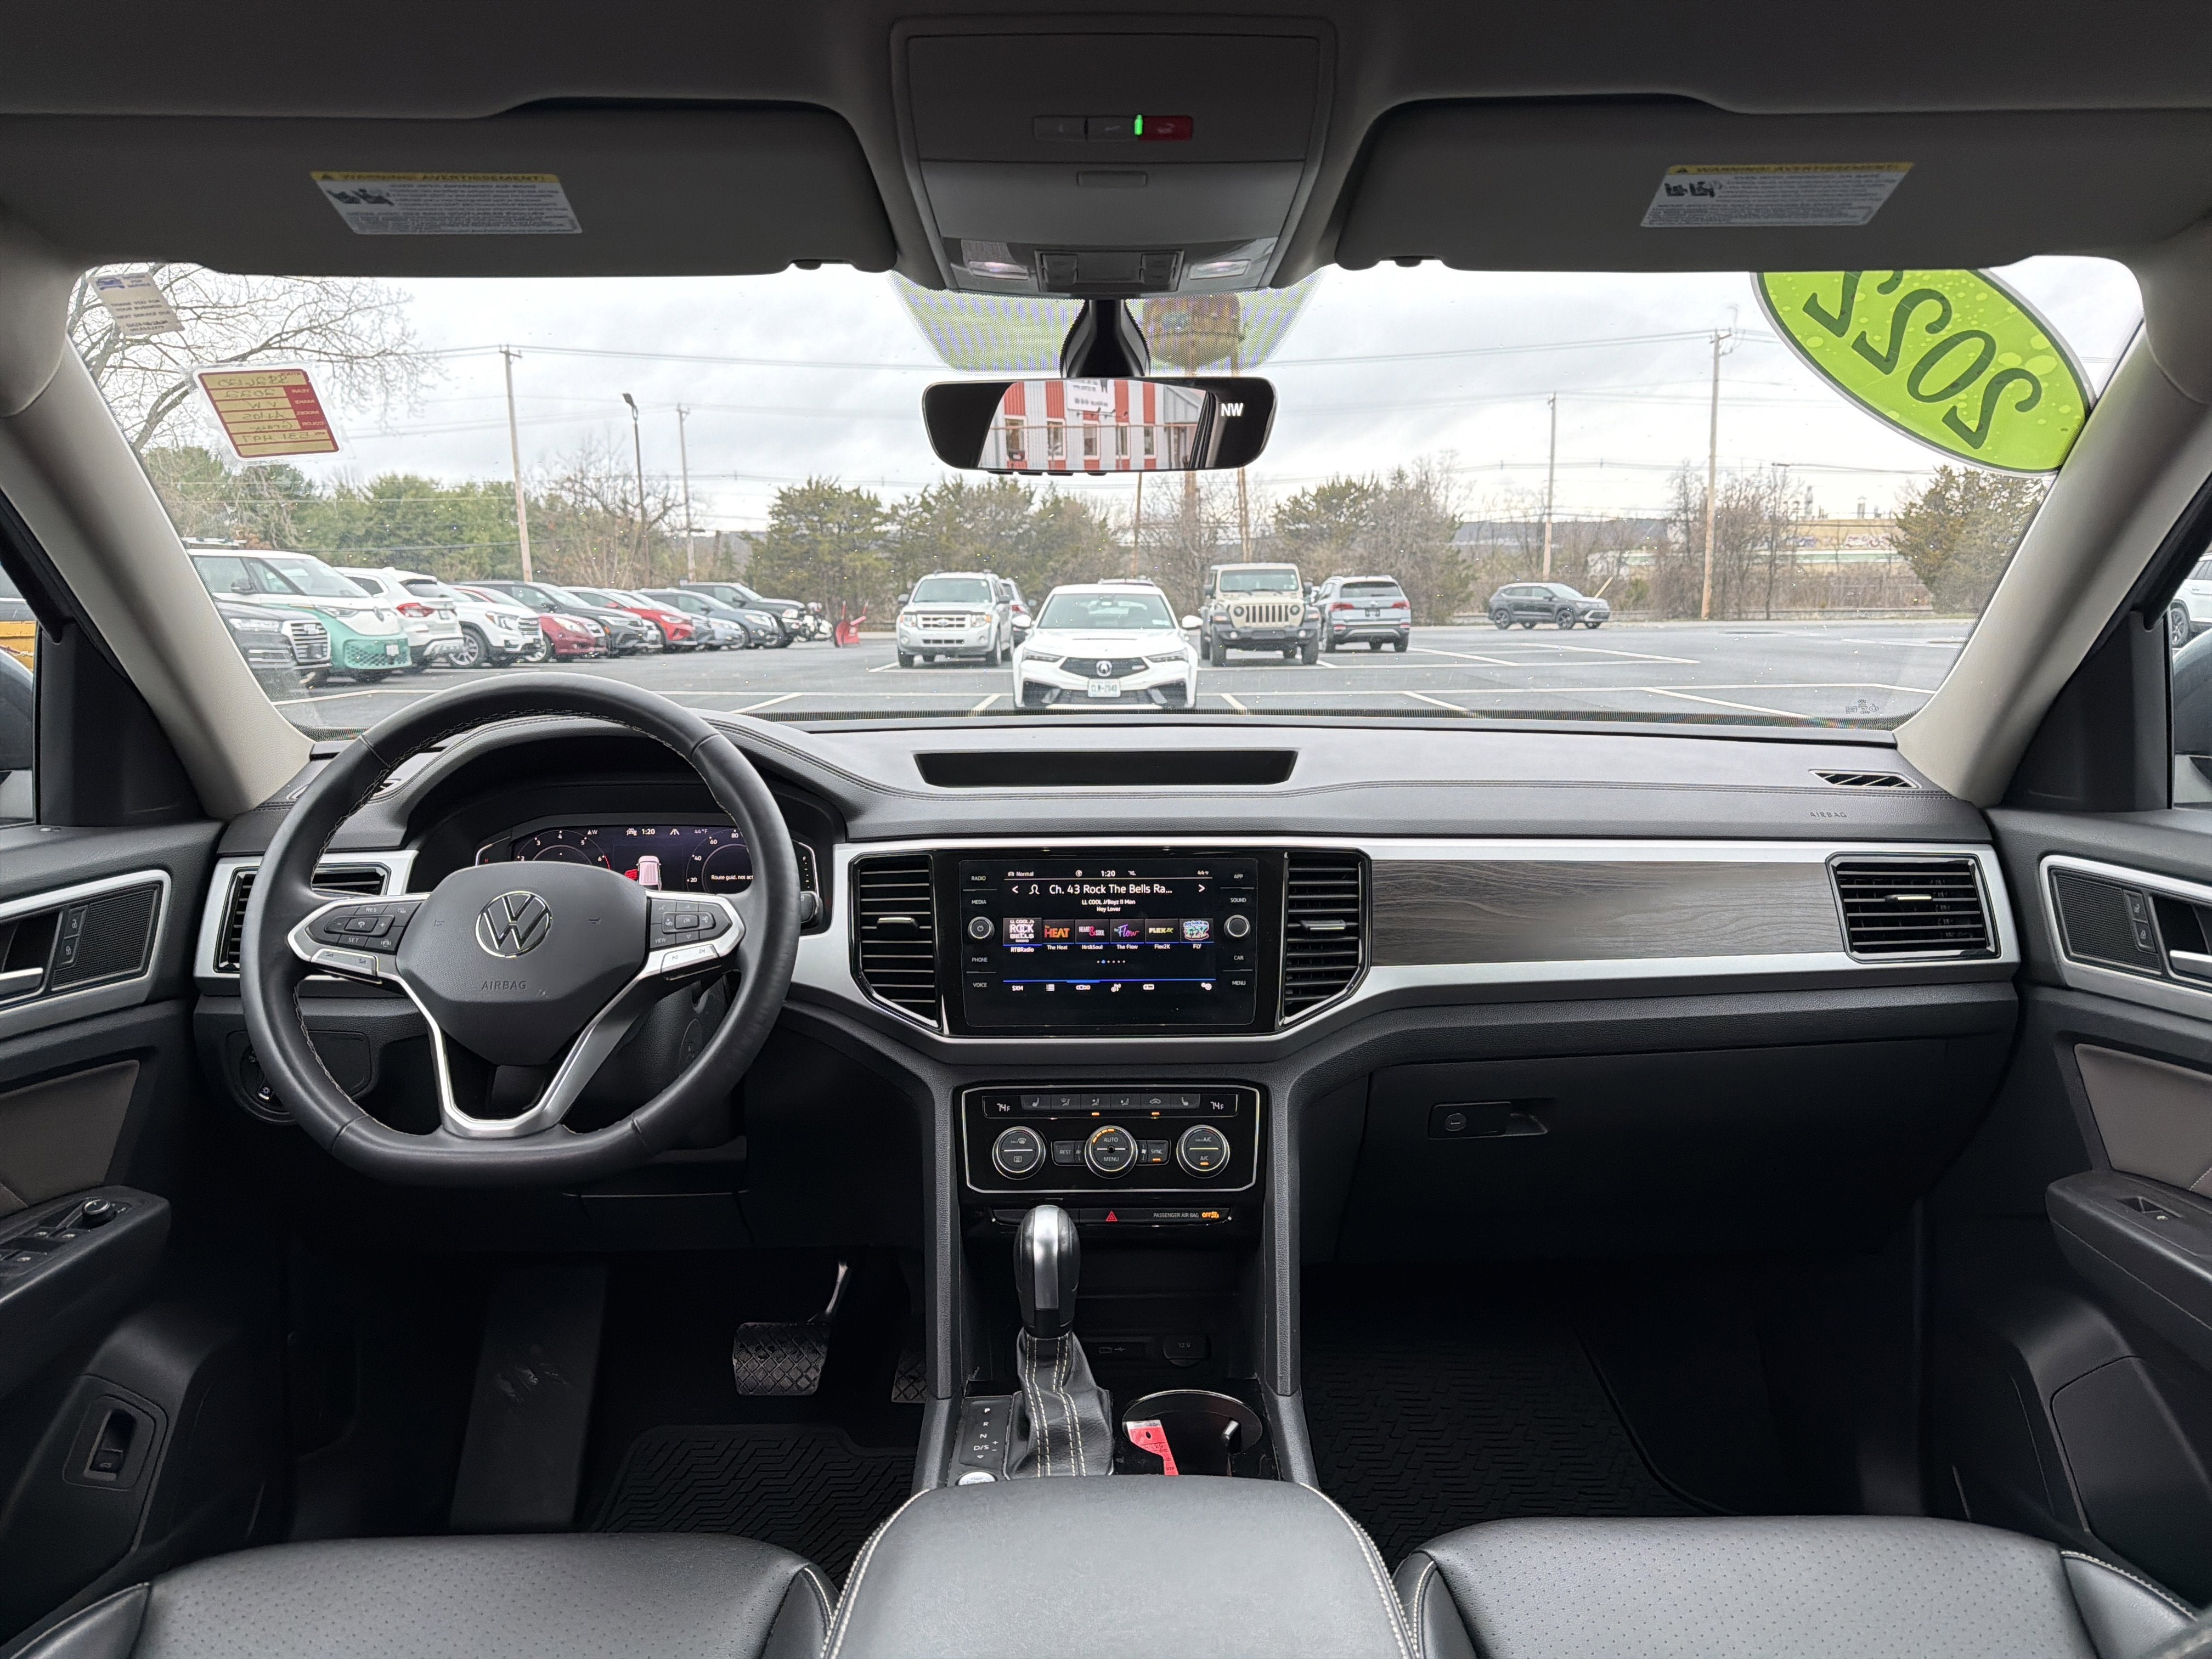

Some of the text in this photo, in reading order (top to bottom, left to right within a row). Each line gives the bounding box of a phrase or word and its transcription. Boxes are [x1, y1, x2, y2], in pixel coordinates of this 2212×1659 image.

[1221, 403, 1244, 416] NW
[1049, 884, 1064, 894] Ch.
[1066, 884, 1080, 894] 43
[1083, 884, 1107, 894] Rock
[1108, 884, 1126, 894] The
[1129, 884, 1151, 894] Bells
[1009, 924, 1034, 933] ROCK
[1044, 928, 1070, 939] HEAT
[481, 980, 527, 990] AIRBAG
